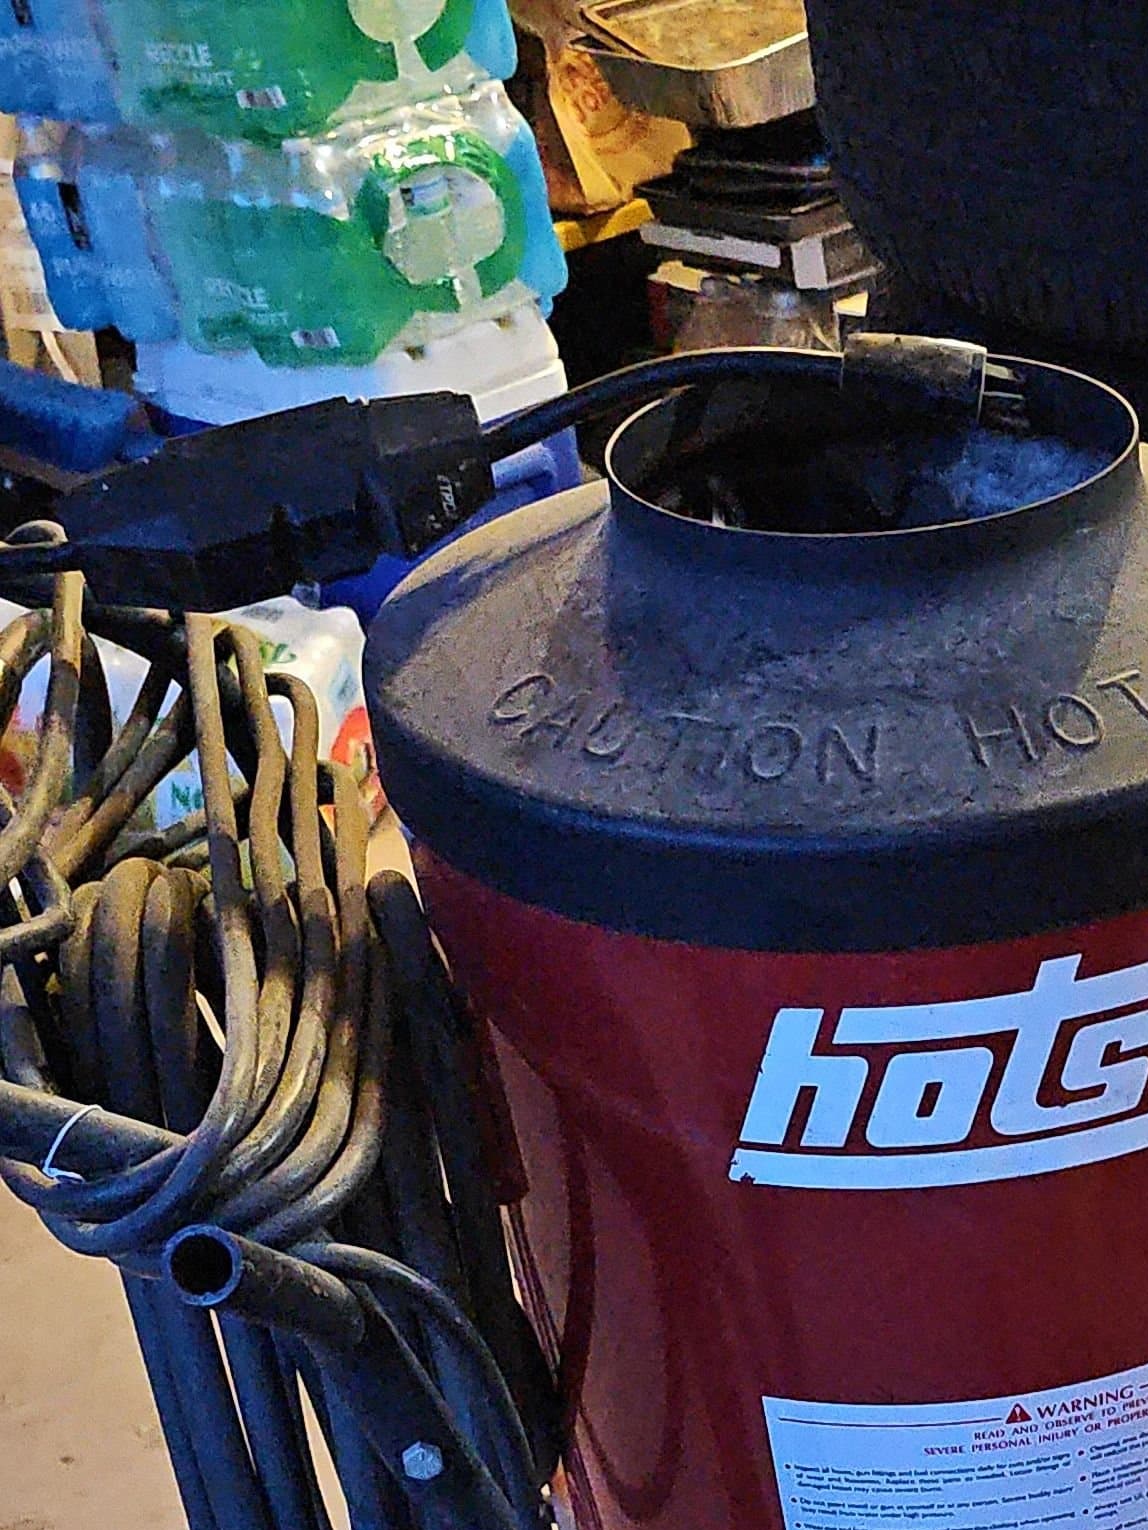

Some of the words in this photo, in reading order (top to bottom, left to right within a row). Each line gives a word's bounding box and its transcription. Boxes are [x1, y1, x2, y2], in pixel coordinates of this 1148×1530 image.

[1036, 1384, 1135, 1419] WARNING
[923, 1445, 964, 1456] SEVERE
[971, 1437, 1032, 1453] PERSONAL
[1038, 1427, 1079, 1444] INJURY
[1084, 1422, 1102, 1434] OR
[974, 1429, 1005, 1441] READ
[1012, 1423, 1039, 1436] AND
[1045, 1412, 1094, 1431] OBSERVE
[1102, 1406, 1117, 1418] TO
